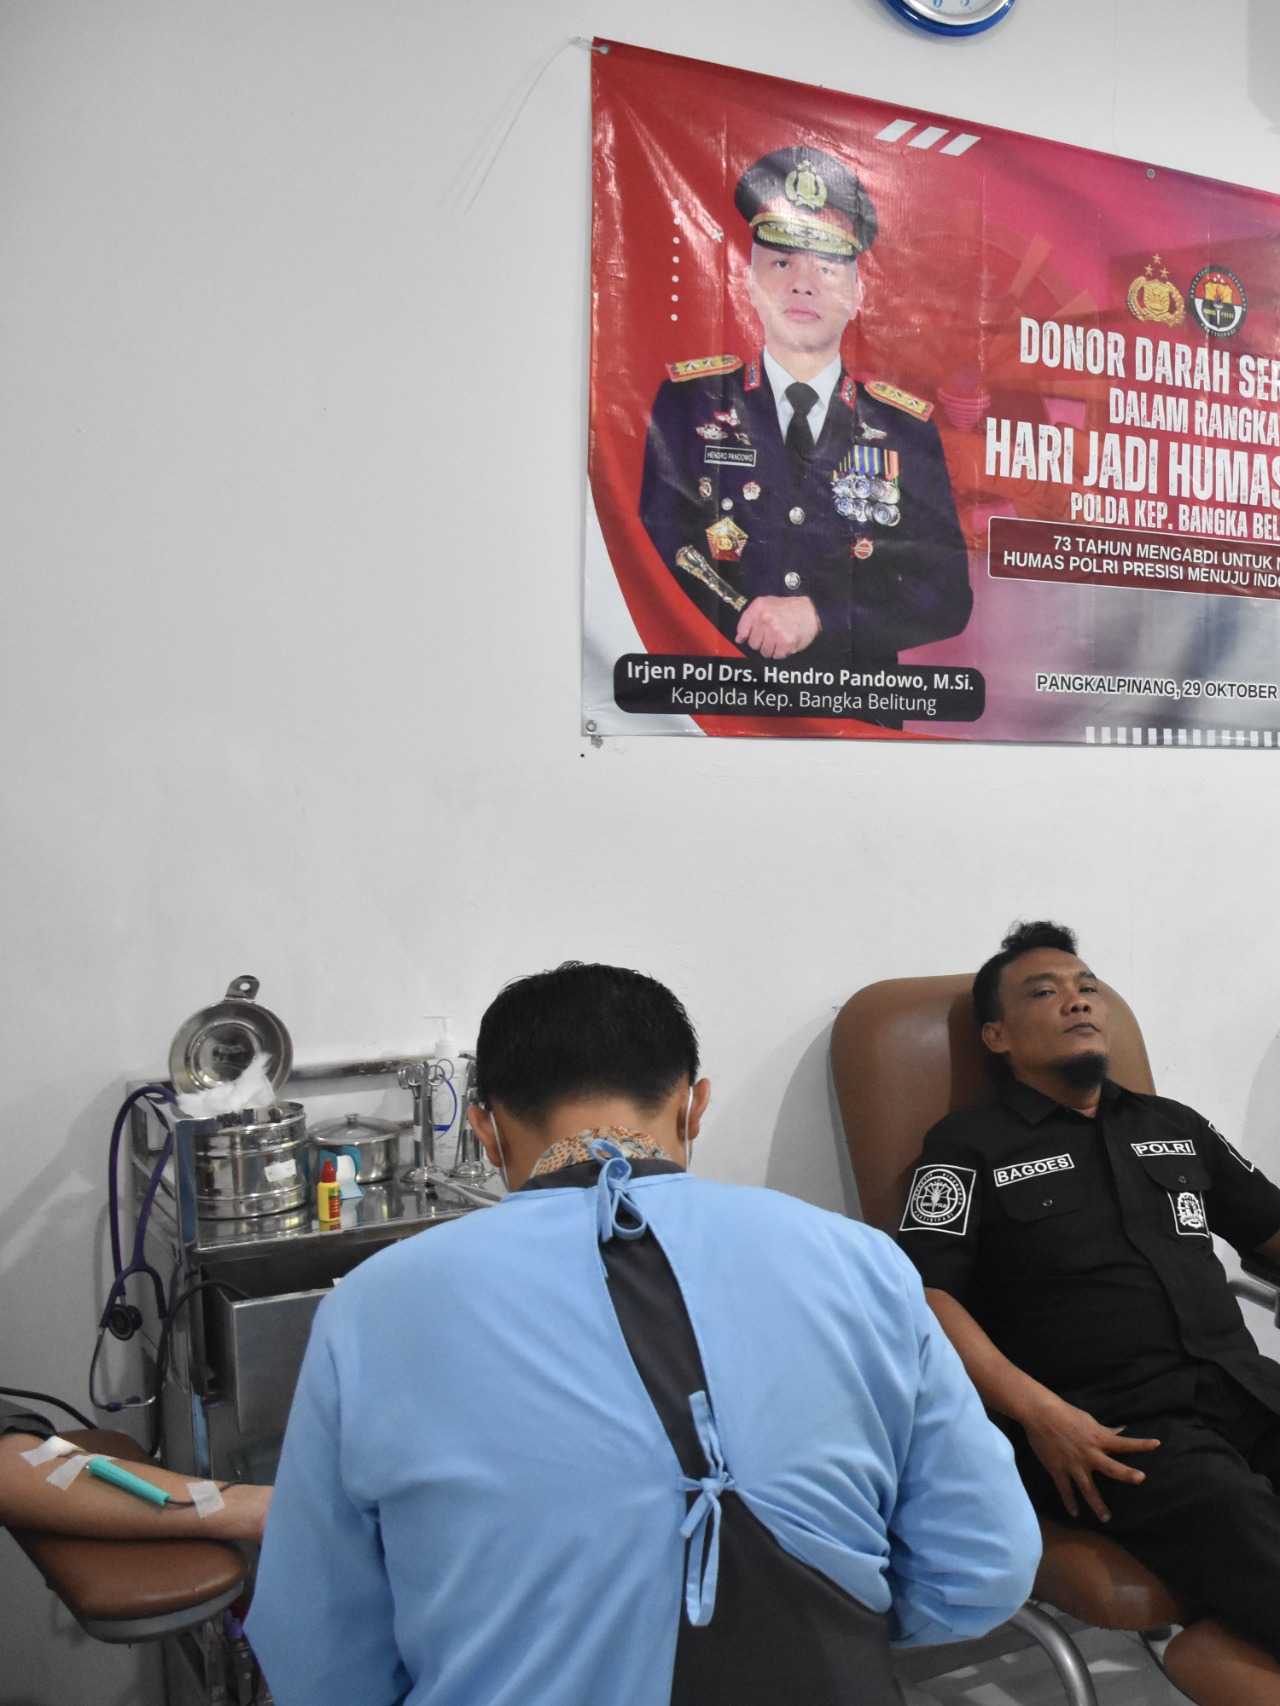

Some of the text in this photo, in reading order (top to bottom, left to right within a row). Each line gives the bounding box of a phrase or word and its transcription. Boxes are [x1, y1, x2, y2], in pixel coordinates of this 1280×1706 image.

[1020, 316, 1125, 378] DONOR
[1135, 336, 1230, 394] DARAH
[1109, 387, 1280, 447] DALAM RANGKA
[985, 417, 1073, 484] HARI
[1083, 431, 1159, 494] JADI
[1071, 492, 1129, 526] POLDA
[1134, 501, 1174, 530] KEP.
[1178, 505, 1248, 538] BANGKA
[1003, 551, 1065, 570] HUMAS
[1069, 556, 1118, 575] POLRI
[1123, 561, 1183, 580] PRESISI
[1188, 566, 1249, 586] MENUJU
[1054, 535, 1072, 551] 73
[1076, 538, 1132, 557] TAHUN
[1136, 543, 1217, 565] MENGABDI
[1222, 552, 1272, 570] UNTUK
[627, 661, 974, 691] Irjen Pol Drs. Hendro Pandowo, M.Si.
[1036, 674, 1181, 699] PANGKALPINANG,
[1184, 681, 1202, 697] 29
[1205, 683, 1278, 699] OKTOBER
[672, 687, 937, 716] Kapolda Kep. Bangka Belitung
[1136, 1142, 1190, 1155] POLRI
[997, 1156, 1069, 1184] BAGOES
